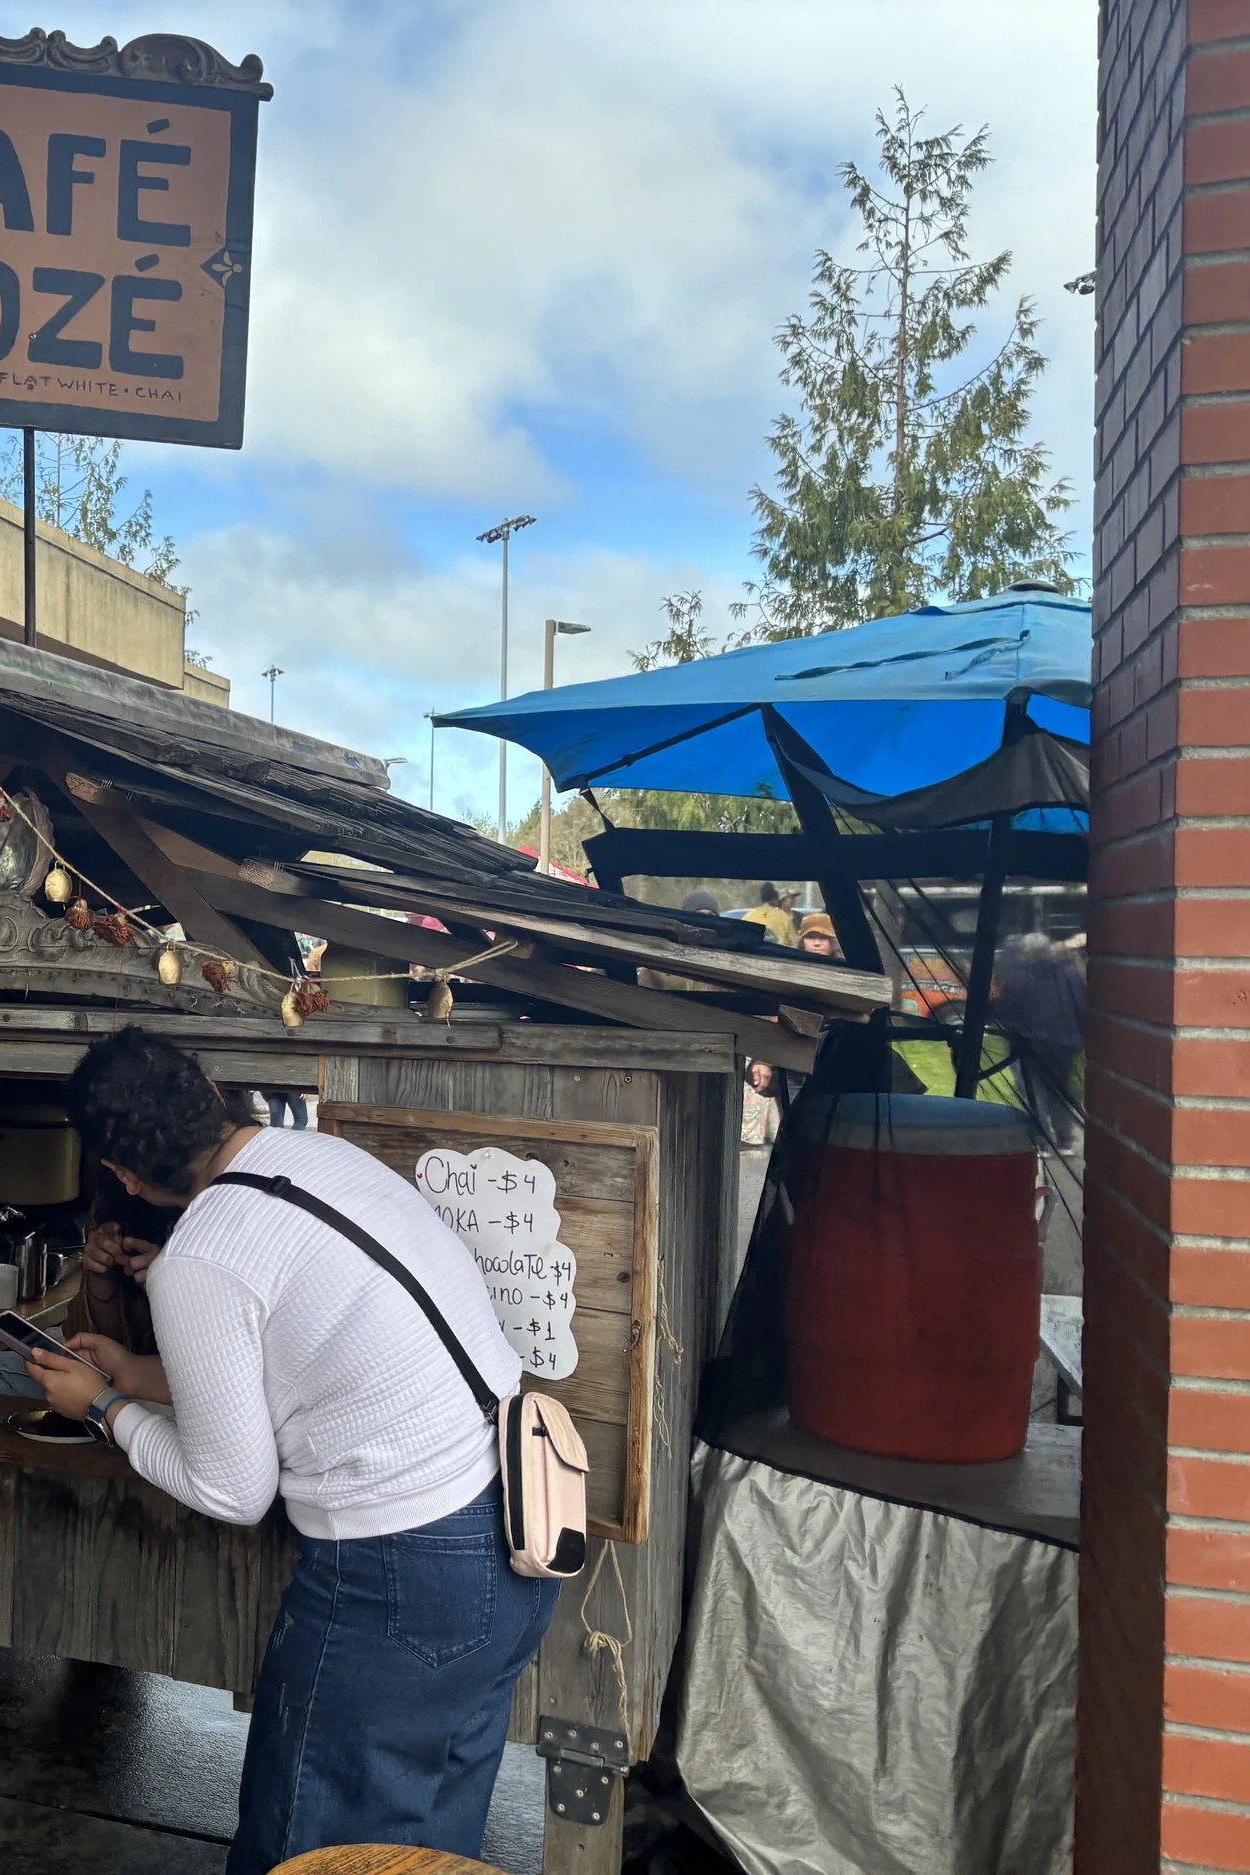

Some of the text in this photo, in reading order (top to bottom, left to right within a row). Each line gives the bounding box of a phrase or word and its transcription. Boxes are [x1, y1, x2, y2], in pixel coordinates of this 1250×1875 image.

[0, 372, 51, 390] FLAT
[57, 378, 118, 396] WHITE
[135, 387, 182, 402] CHAI
[425, 1156, 477, 1195] Chai
[474, 1248, 548, 1280] hocolaTe
